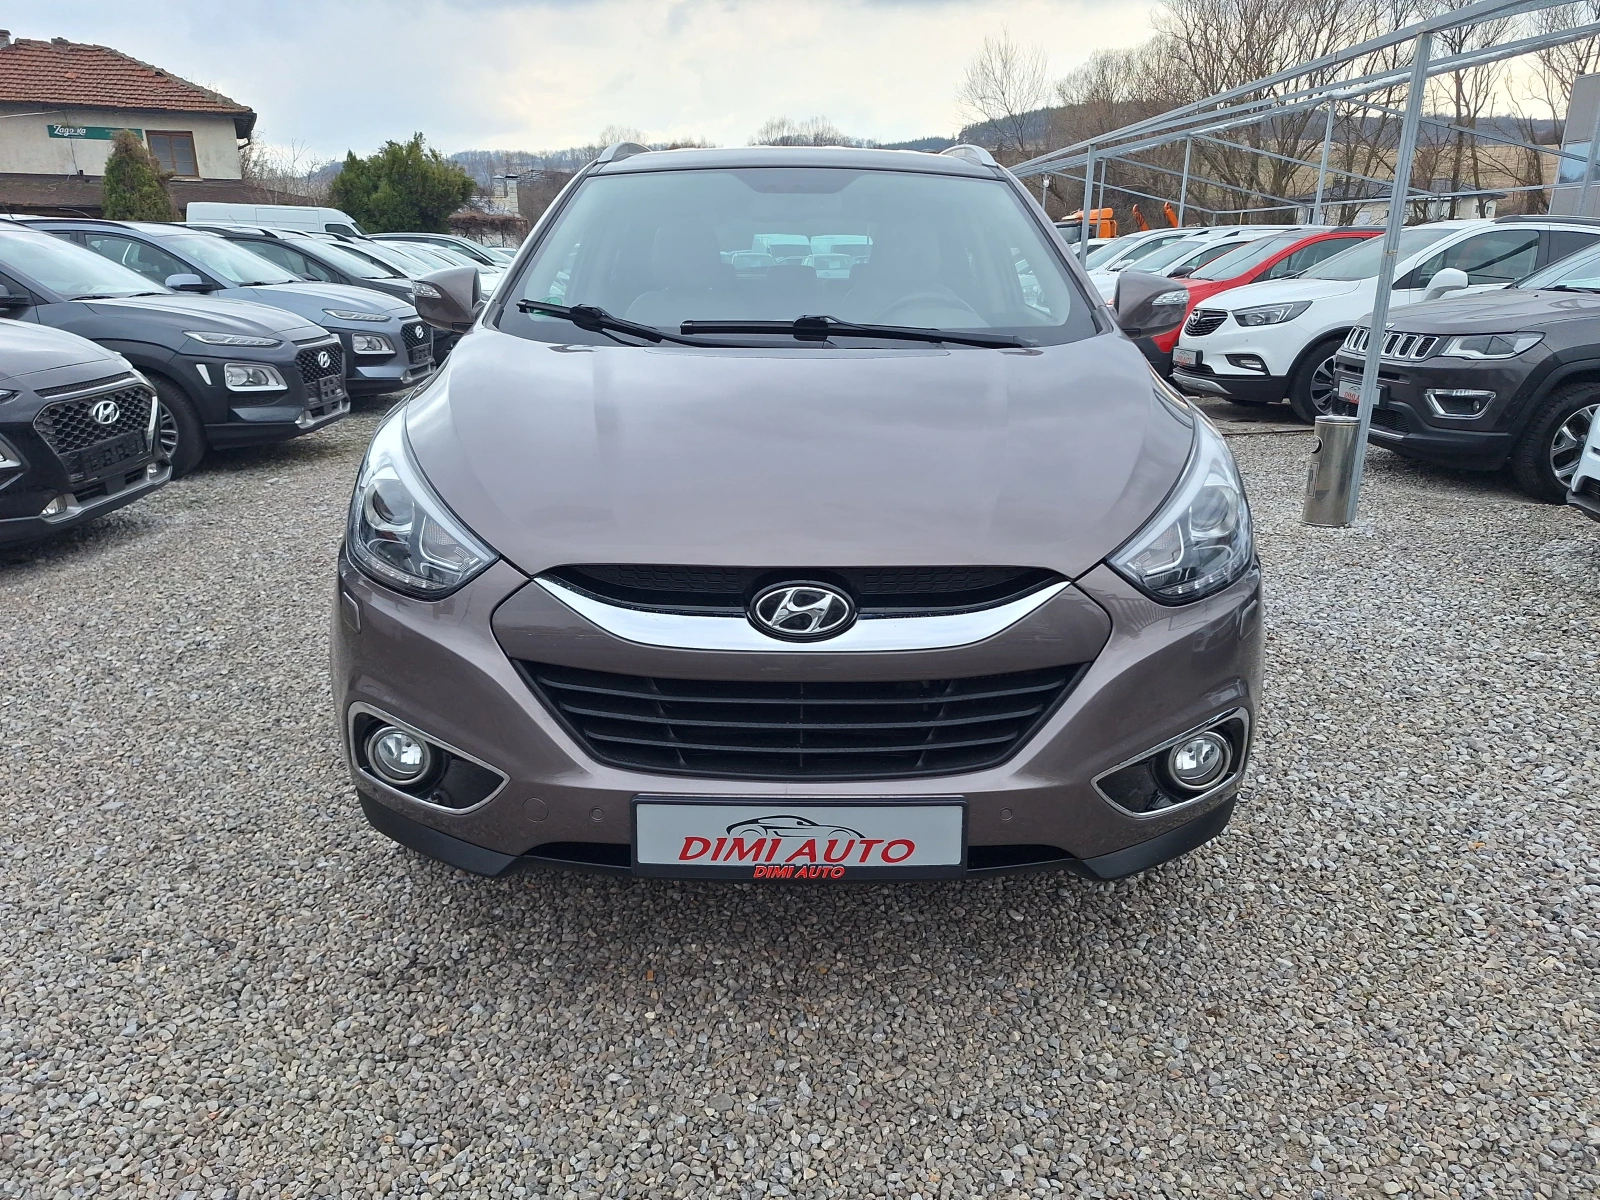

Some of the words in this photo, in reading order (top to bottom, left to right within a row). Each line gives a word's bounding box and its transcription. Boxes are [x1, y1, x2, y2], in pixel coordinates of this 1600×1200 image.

[53, 124, 87, 136] Zagoka
[678, 836, 784, 863] DIMI
[784, 838, 916, 864] AUTO
[753, 865, 795, 879] DIMI
[794, 865, 846, 879] AUTO
